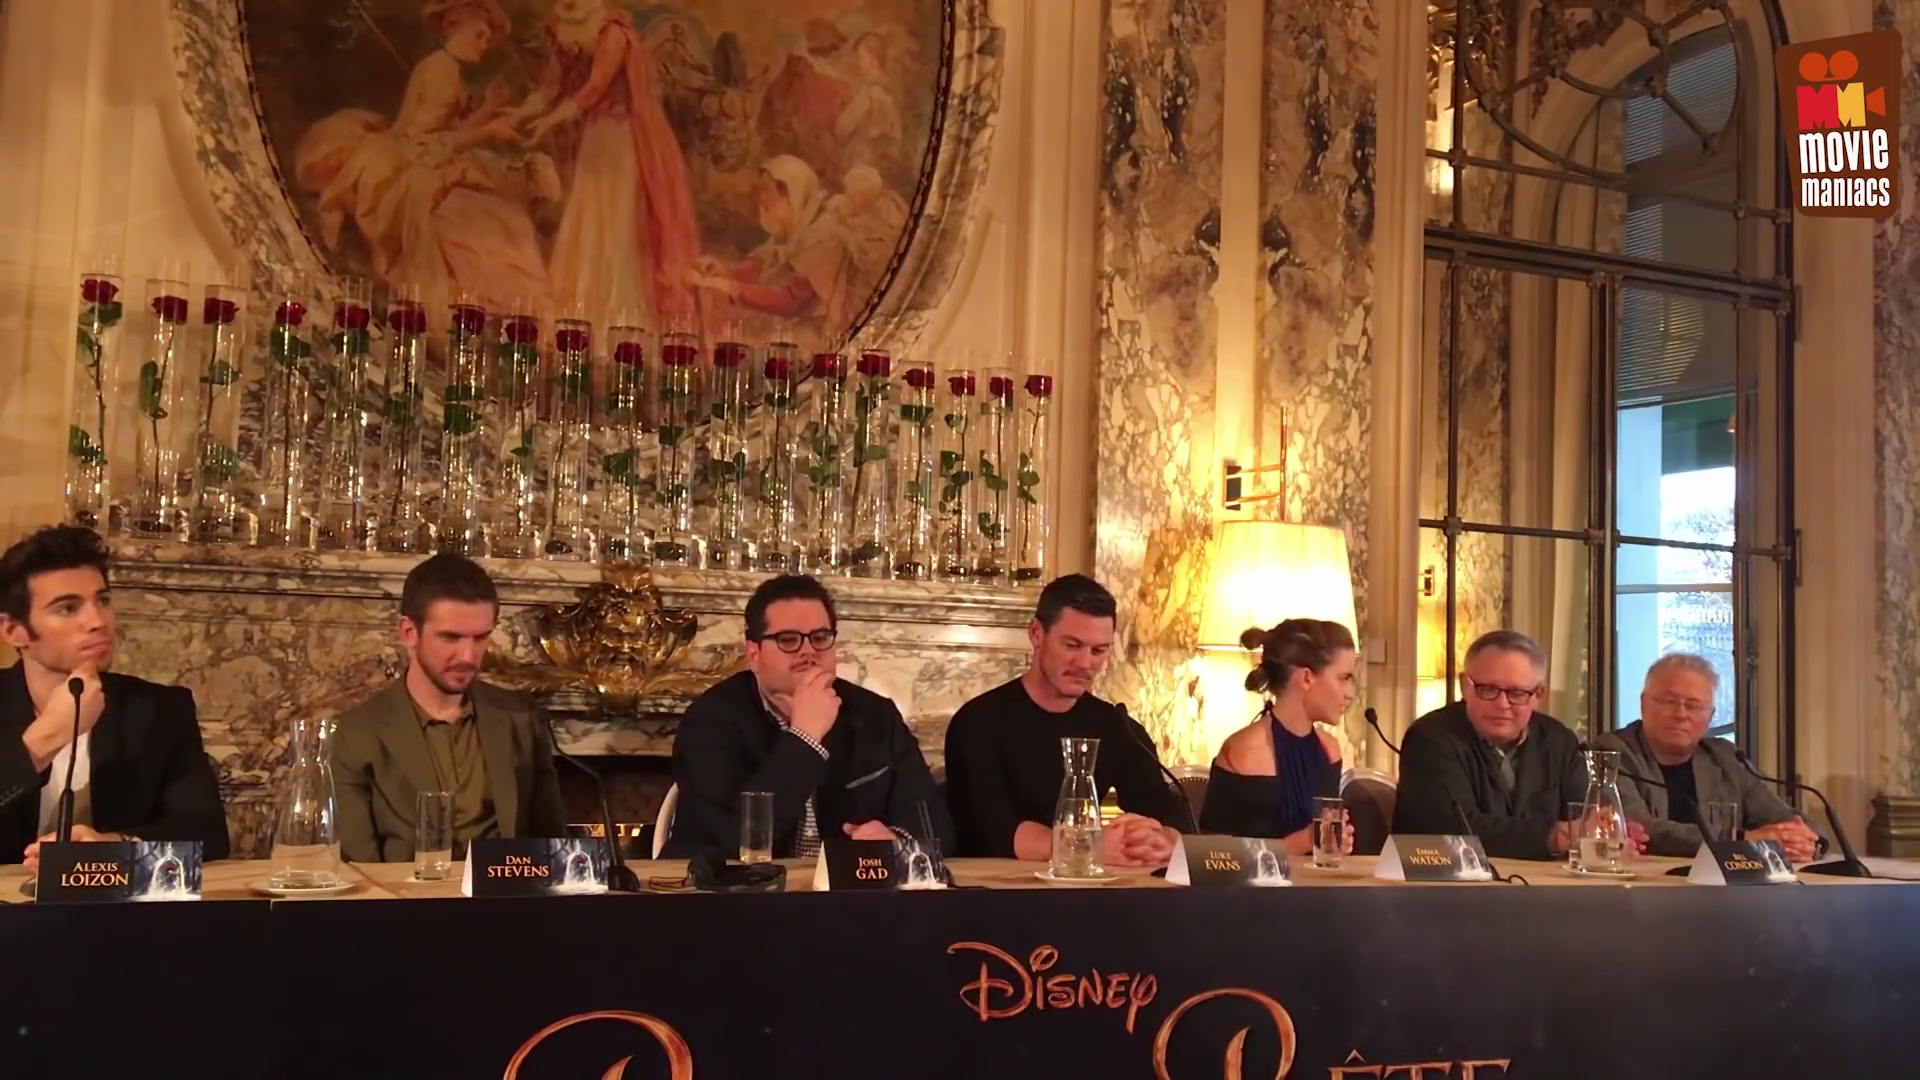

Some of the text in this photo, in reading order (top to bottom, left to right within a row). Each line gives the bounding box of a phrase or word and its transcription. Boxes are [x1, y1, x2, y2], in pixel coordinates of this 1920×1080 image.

[1210, 851, 1231, 860] LUKE
[1416, 847, 1440, 856] EMMA
[506, 855, 531, 865] DAN
[858, 857, 882, 868] JOSH
[1205, 860, 1240, 871] EVANS
[1409, 855, 1452, 866] WATSON
[73, 862, 118, 872] ALEXIS
[487, 865, 549, 878] STEVENS
[1724, 861, 1763, 871] CONDON
[856, 868, 888, 879] GAD
[61, 873, 129, 886] LOIZON
